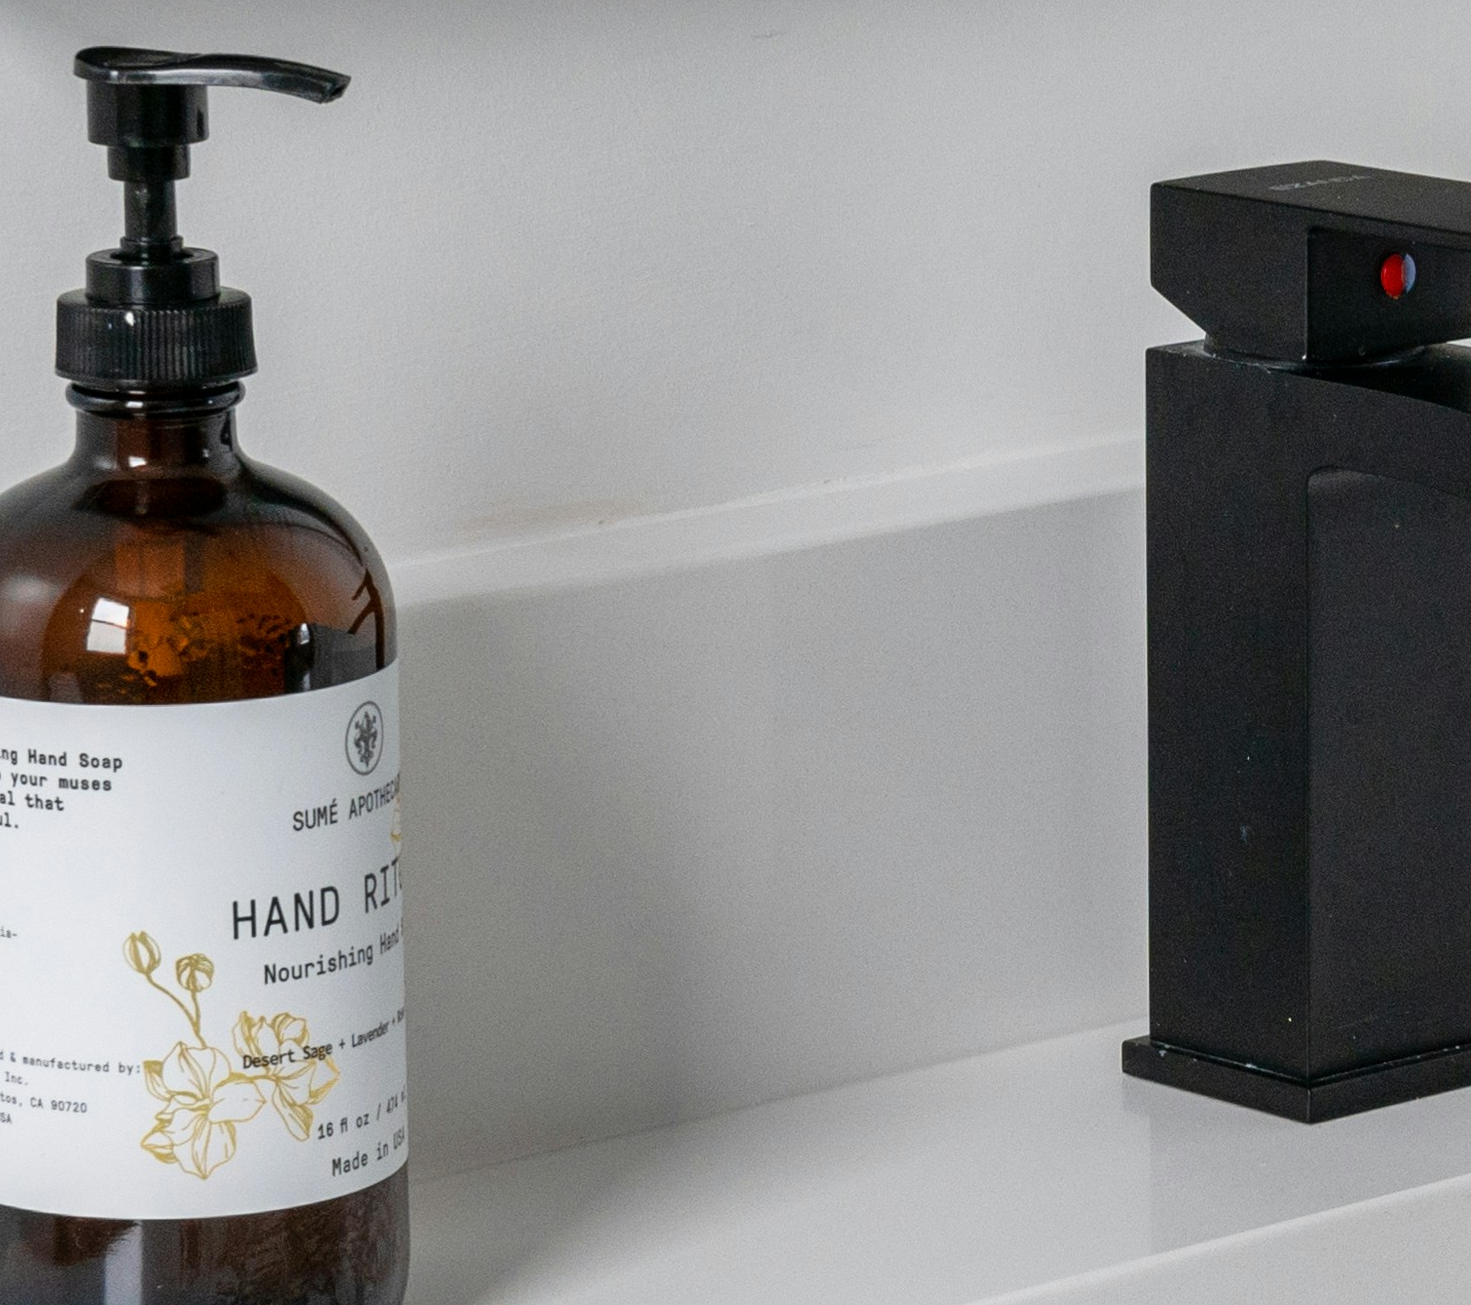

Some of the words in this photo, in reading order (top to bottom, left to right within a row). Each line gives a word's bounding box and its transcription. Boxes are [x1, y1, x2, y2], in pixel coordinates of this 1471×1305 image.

[28, 748, 67, 767] Hand
[79, 753, 123, 773] Soap
[11, 772, 48, 787] your
[58, 777, 112, 791] muses
[24, 794, 65, 811] that
[292, 798, 338, 831] SUMÉ
[349, 773, 401, 819] APOTHEC
[233, 886, 340, 940] HAND
[364, 857, 402, 914] RIT
[265, 945, 374, 985] Nourishing
[380, 928, 400, 955] Hand
[243, 1049, 296, 1069] Desert
[303, 1043, 333, 1061] Sage
[351, 1020, 390, 1048] Lavender
[10, 1052, 17, 1063] &
[22, 1056, 110, 1073] manufactured
[119, 1062, 141, 1076] by:
[5, 1071, 29, 1086] Inc.
[30, 1096, 44, 1109] CA
[50, 1099, 88, 1113] 90720
[317, 1122, 334, 1140] 16
[340, 1117, 348, 1134] fl
[356, 1113, 370, 1128] oz
[332, 1151, 369, 1177] Made
[377, 1142, 389, 1160] in
